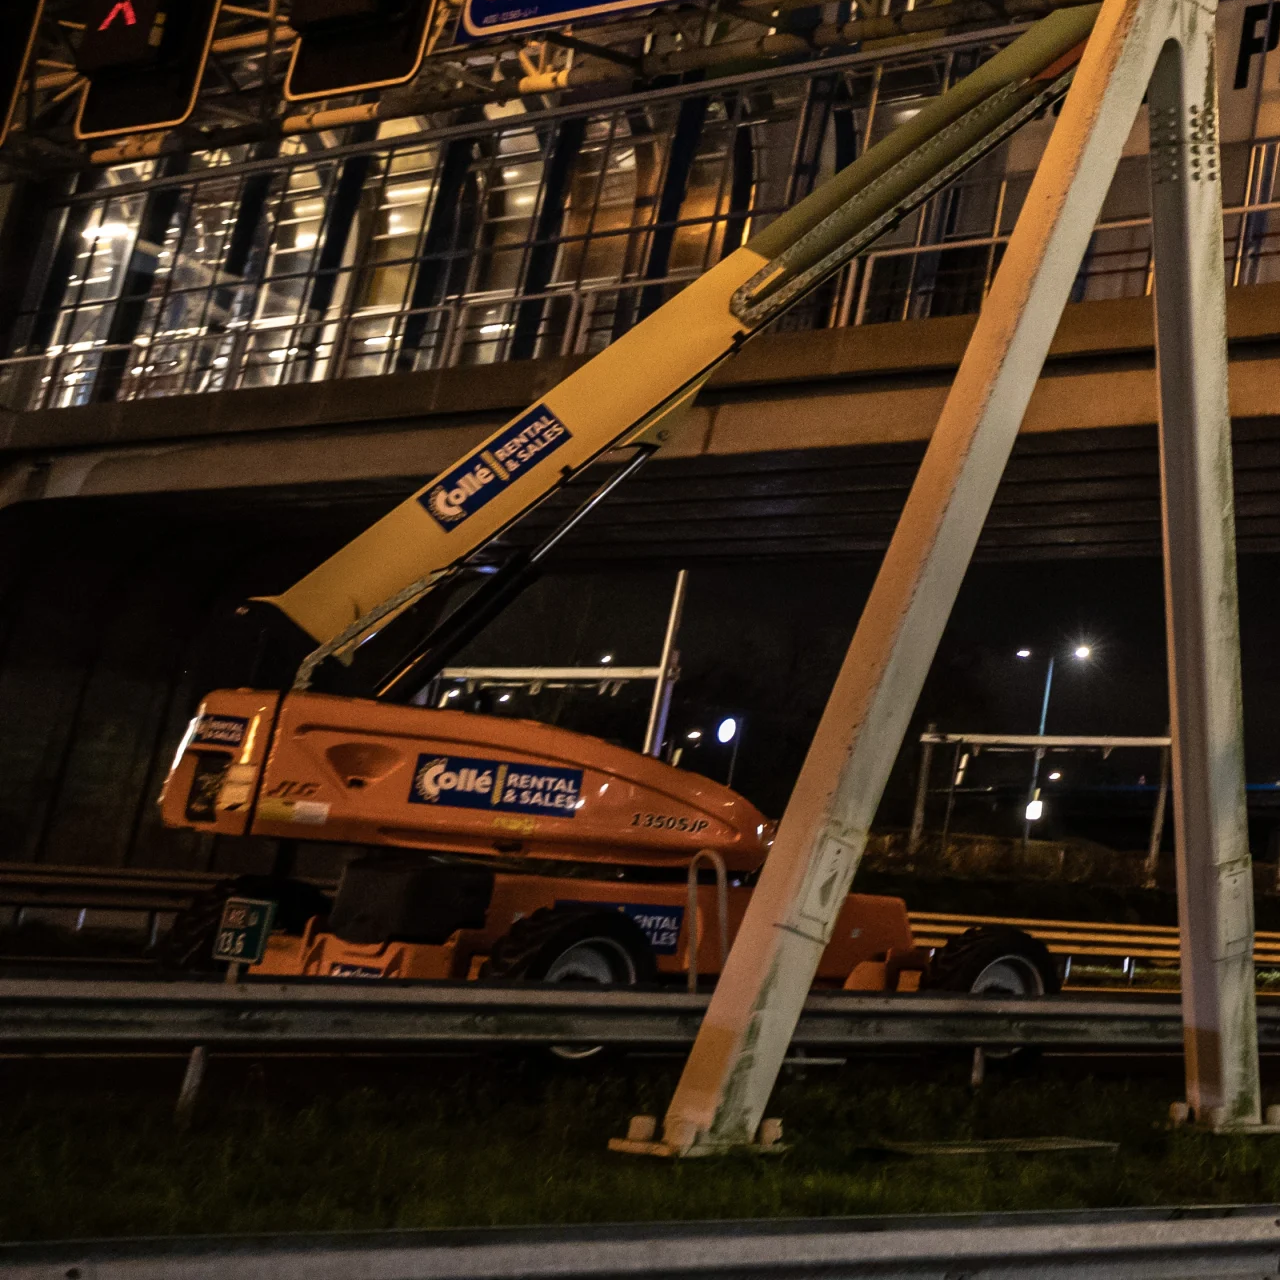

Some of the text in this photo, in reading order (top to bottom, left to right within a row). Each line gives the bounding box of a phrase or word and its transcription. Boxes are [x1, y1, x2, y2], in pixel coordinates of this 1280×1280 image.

[494, 415, 556, 461] RENTAL
[504, 423, 565, 472] & SALES
[428, 464, 496, 521] Collé
[415, 758, 494, 803] Collé
[503, 788, 578, 809] & SALES
[506, 773, 579, 794] RENTAL
[646, 930, 678, 946] LES
